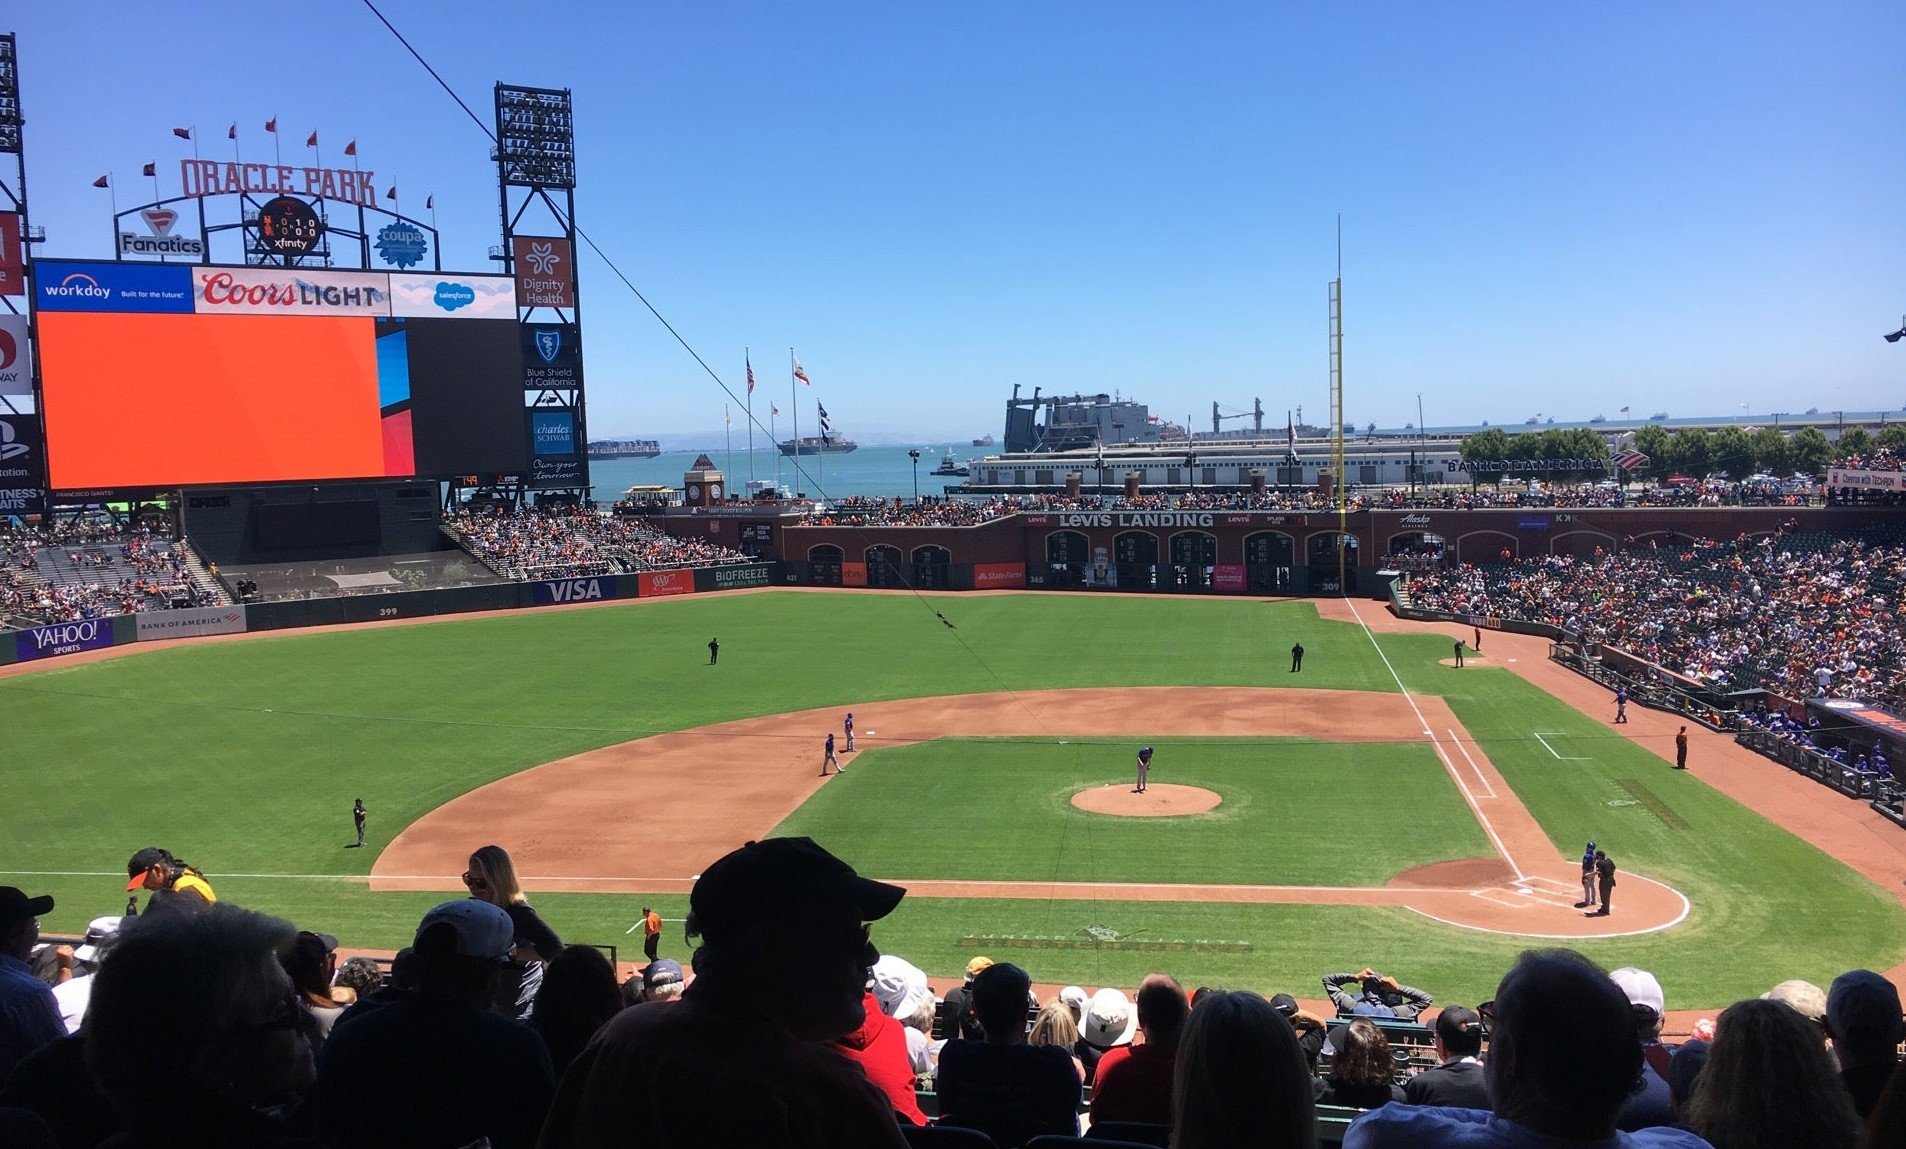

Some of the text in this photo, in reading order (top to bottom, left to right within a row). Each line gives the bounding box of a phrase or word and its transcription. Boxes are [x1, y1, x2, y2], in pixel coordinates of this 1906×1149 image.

[180, 159, 377, 209] ORACLE PARK
[382, 230, 422, 245] coupa
[122, 235, 201, 253] Fanatics
[274, 238, 308, 250] xfinity
[202, 272, 375, 307] Coors LIGHT
[524, 278, 564, 292] Dignity
[45, 285, 110, 299] workday
[438, 292, 472, 300] salesforce
[526, 292, 564, 304] Health
[527, 368, 572, 376] Blue Shield
[524, 378, 576, 386] of California
[537, 424, 570, 434] charles
[554, 462, 578, 472] your
[1448, 458, 1605, 472] BANK OF AMERICA
[533, 470, 580, 480] tomorrow
[1119, 514, 1214, 528] LANDING
[1400, 514, 1430, 524] Alaska
[654, 574, 668, 585] AAA
[988, 570, 1022, 580] State Farm
[545, 579, 602, 602] VISA
[1322, 583, 1340, 592] 309
[380, 608, 398, 616] 399
[181, 618, 222, 628] AMERICA
[32, 620, 97, 650] YAHOO!
[54, 644, 82, 655] SPORTS
